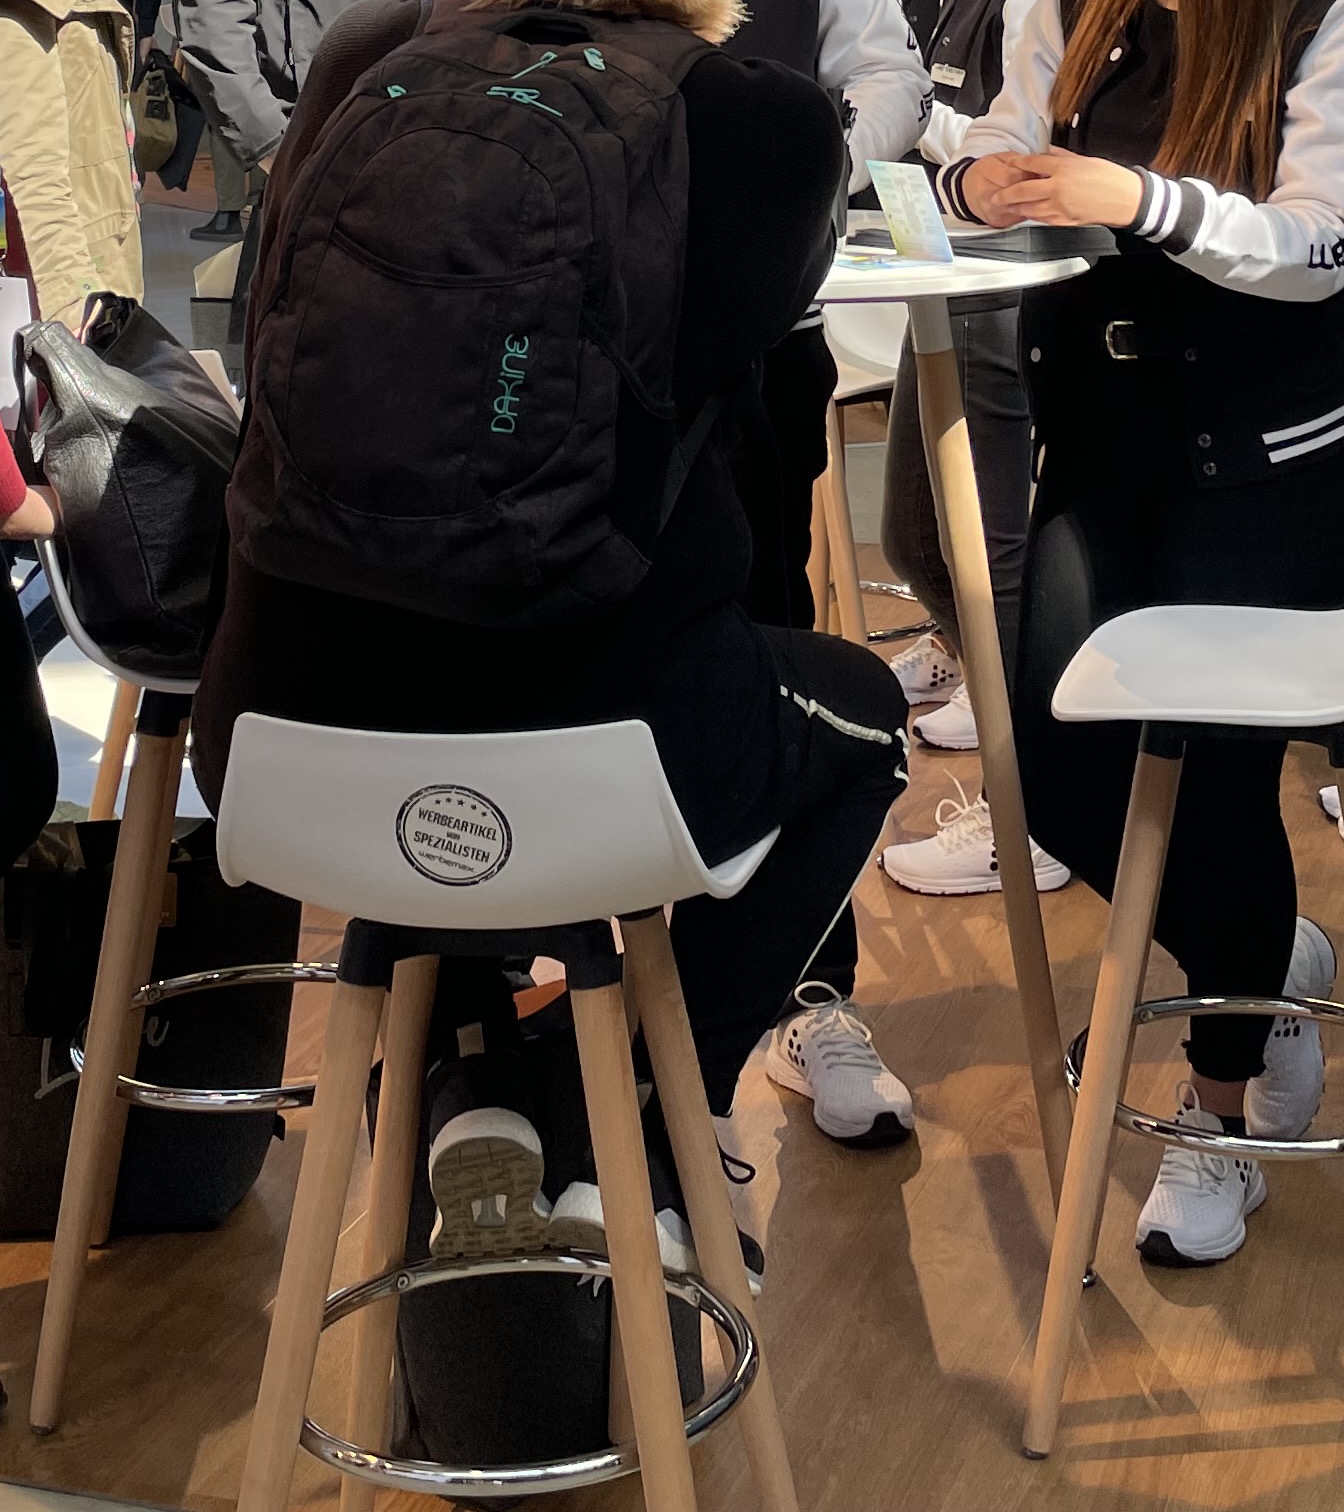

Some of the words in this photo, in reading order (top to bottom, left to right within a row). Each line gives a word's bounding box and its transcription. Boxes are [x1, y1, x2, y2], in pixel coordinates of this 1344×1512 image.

[418, 807, 497, 841] WERBEARTIKEL
[413, 830, 490, 863] SPEZIALISTEN
[418, 850, 475, 873] werbemax
